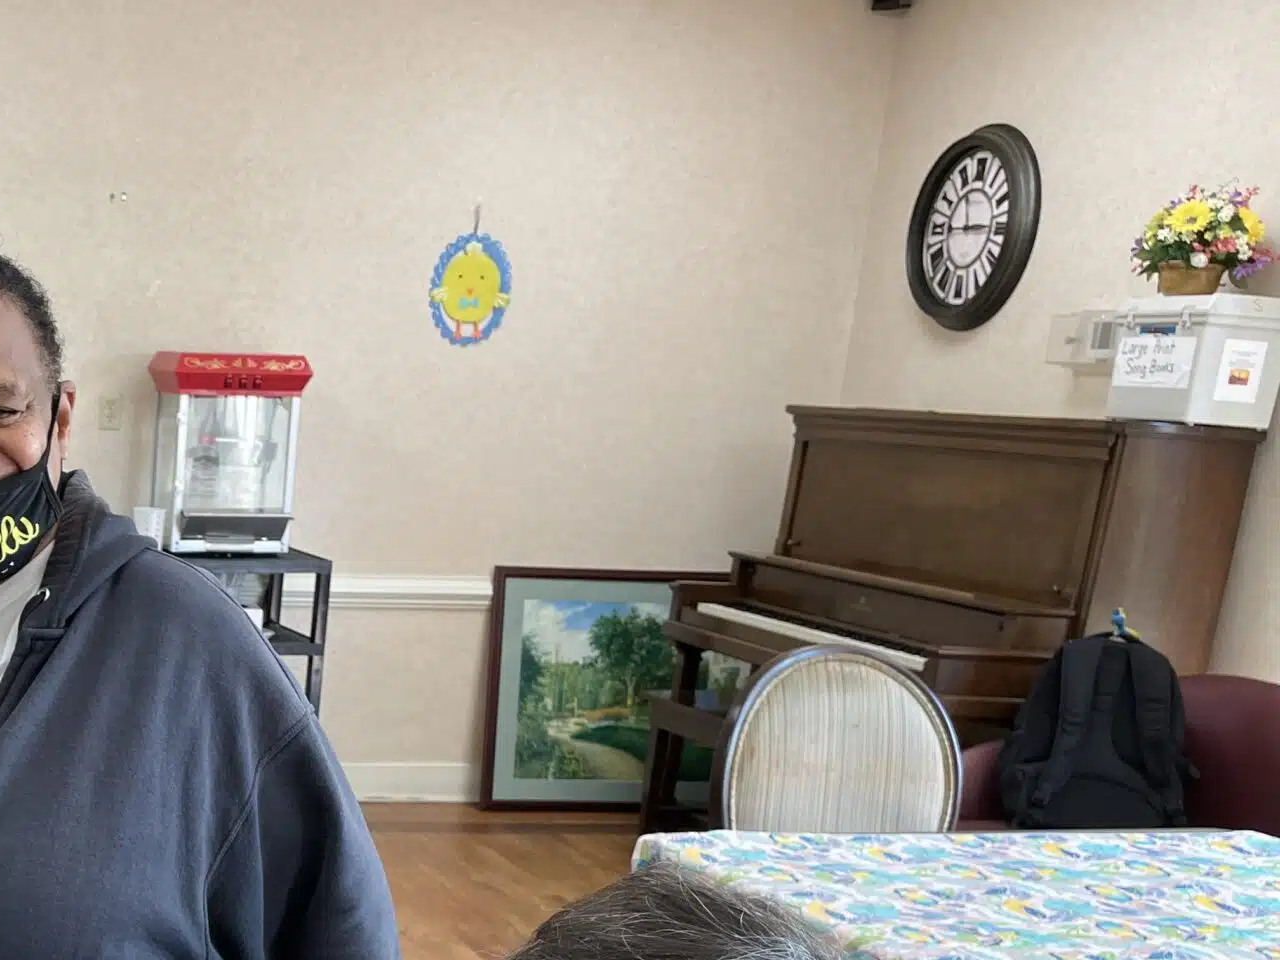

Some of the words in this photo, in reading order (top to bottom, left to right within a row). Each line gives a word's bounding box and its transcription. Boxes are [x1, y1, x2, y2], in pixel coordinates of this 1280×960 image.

[1121, 338, 1148, 360] Large
[1125, 358, 1148, 379] Song
[1149, 358, 1175, 374] Books
